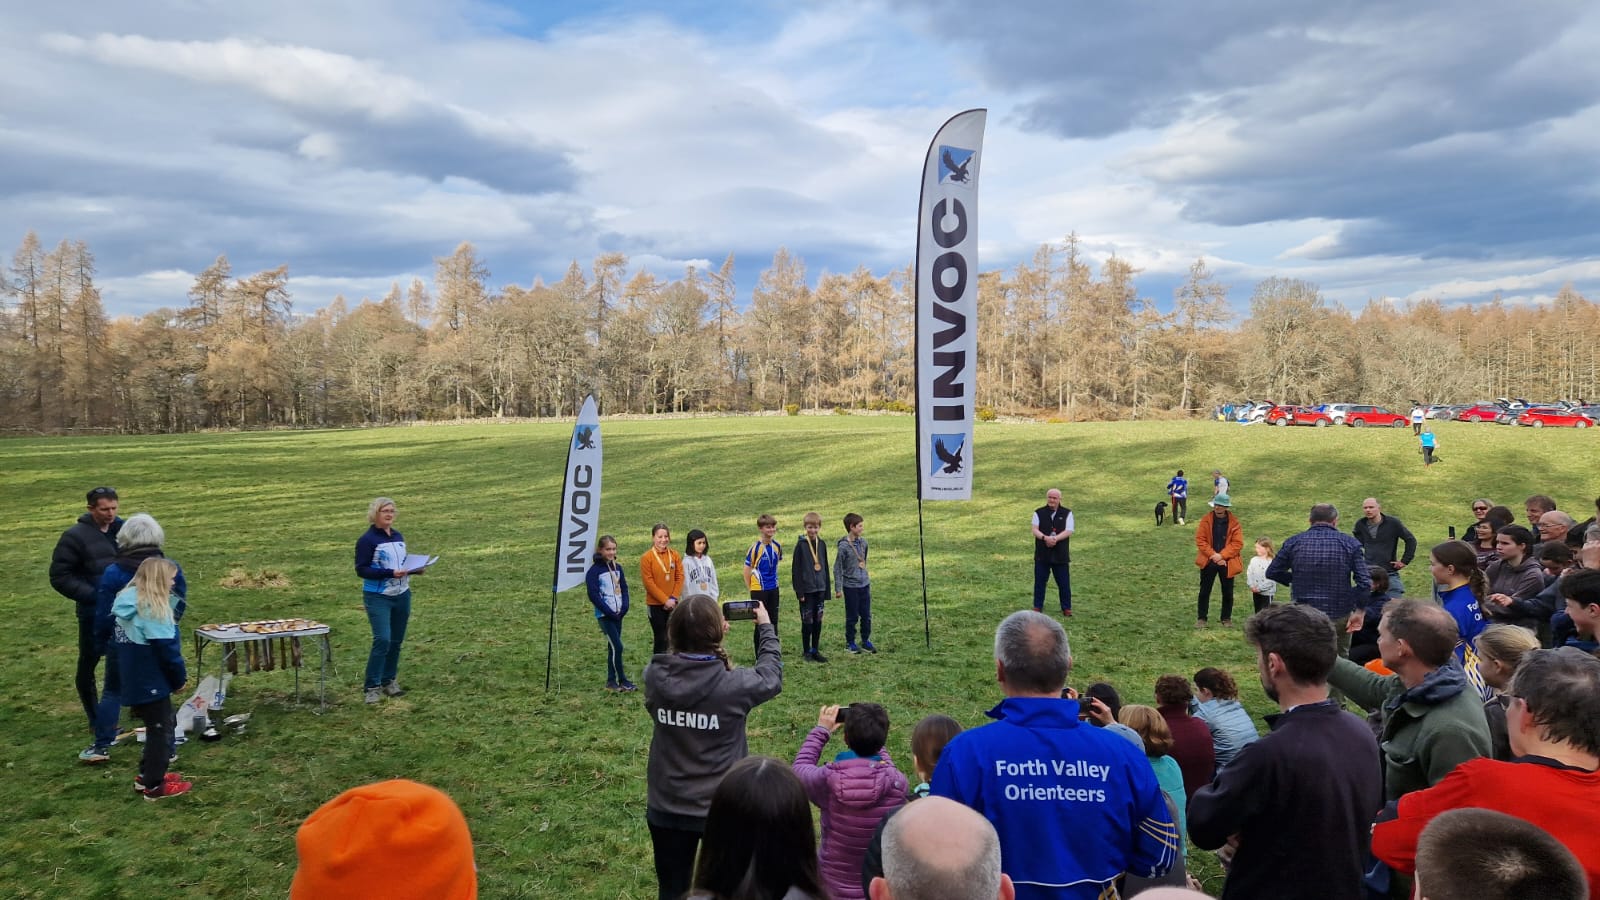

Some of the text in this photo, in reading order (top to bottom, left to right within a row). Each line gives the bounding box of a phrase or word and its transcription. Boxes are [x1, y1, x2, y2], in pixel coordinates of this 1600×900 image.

[931, 196, 968, 421] INVOC
[566, 464, 593, 574] INVOC
[657, 707, 720, 730] GLENDA
[995, 758, 1110, 782] Forth Valley
[1004, 783, 1106, 803] Orienteers
